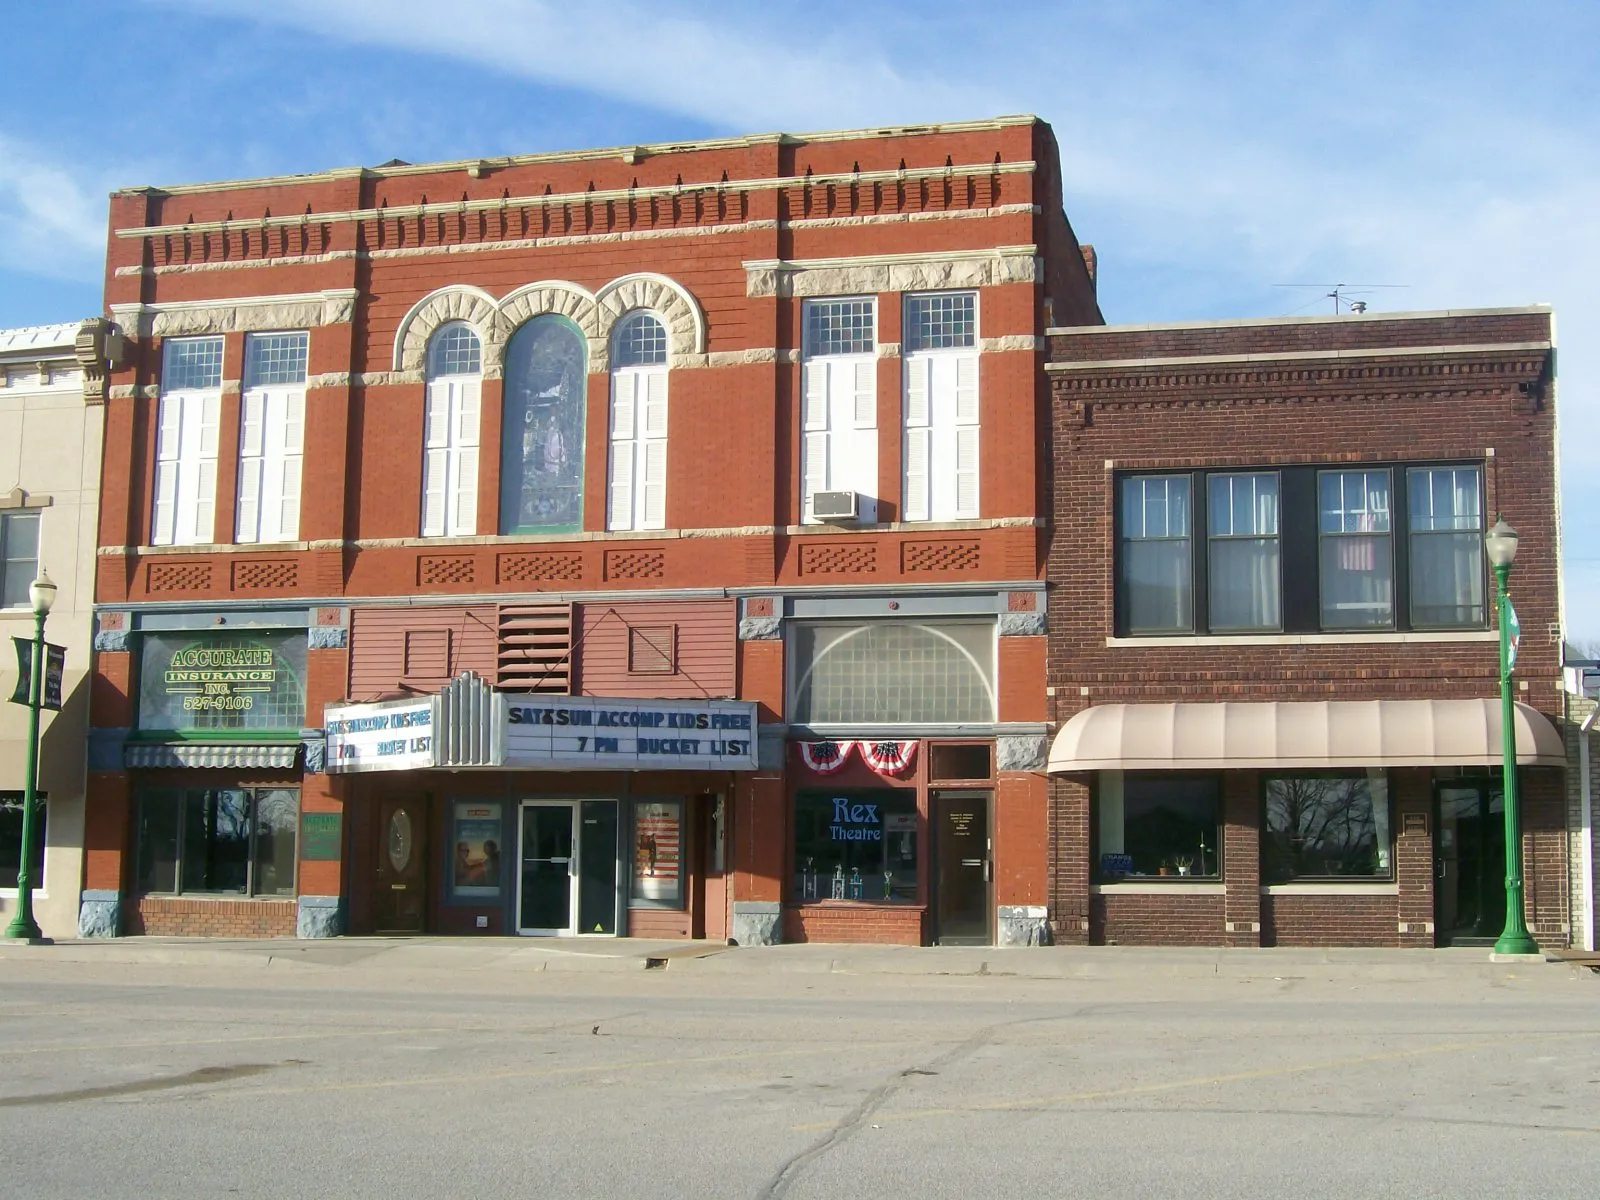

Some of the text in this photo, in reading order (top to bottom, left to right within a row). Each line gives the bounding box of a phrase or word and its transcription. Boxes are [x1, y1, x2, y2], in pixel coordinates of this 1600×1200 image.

[170, 648, 273, 668] ACCURATE
[169, 671, 273, 681] INSURANCE
[205, 683, 231, 695] INC.
[183, 696, 254, 710] 527-9106
[409, 709, 431, 726] FREE
[598, 710, 665, 728] ACCOMP
[668, 712, 709, 730] KIDS
[711, 714, 751, 731] FREE
[410, 736, 431, 753] LIST
[577, 736, 751, 756] 7 PM BUCKET LIST
[832, 797, 880, 823] Rex
[829, 825, 881, 841] Theatre
